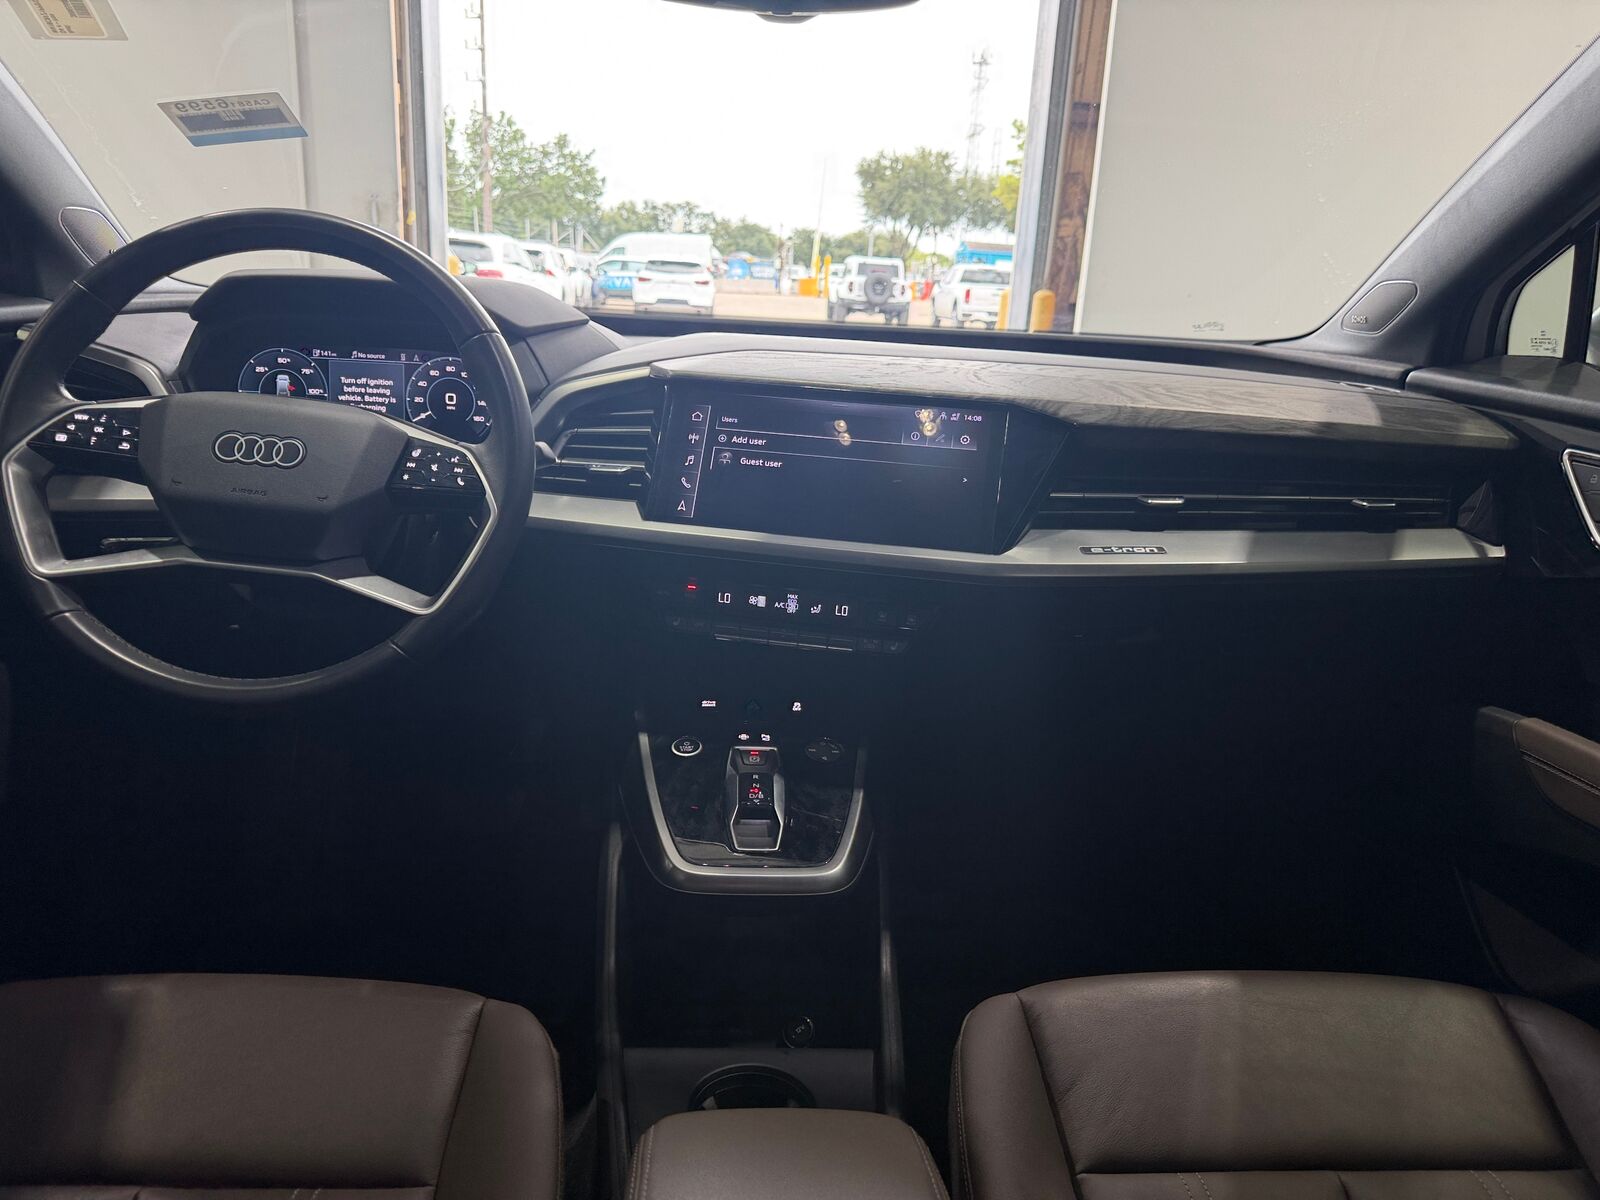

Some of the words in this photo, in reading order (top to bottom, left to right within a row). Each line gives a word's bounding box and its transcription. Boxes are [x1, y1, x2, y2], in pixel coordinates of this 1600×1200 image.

[340, 376, 356, 384] Turn
[356, 377, 367, 385] off
[367, 378, 394, 386] ignition
[343, 385, 366, 393] before
[366, 386, 391, 396] leaving
[338, 394, 364, 402] vehicle.
[364, 395, 390, 405] Battery
[390, 396, 397, 404] is
[73, 413, 90, 421] VIEW
[964, 414, 982, 422] 14:08
[93, 426, 105, 434] OK
[731, 435, 748, 444] Add
[749, 438, 767, 446] user
[740, 457, 763, 467] Guest
[764, 459, 783, 468] user
[774, 601, 786, 609] A/C
